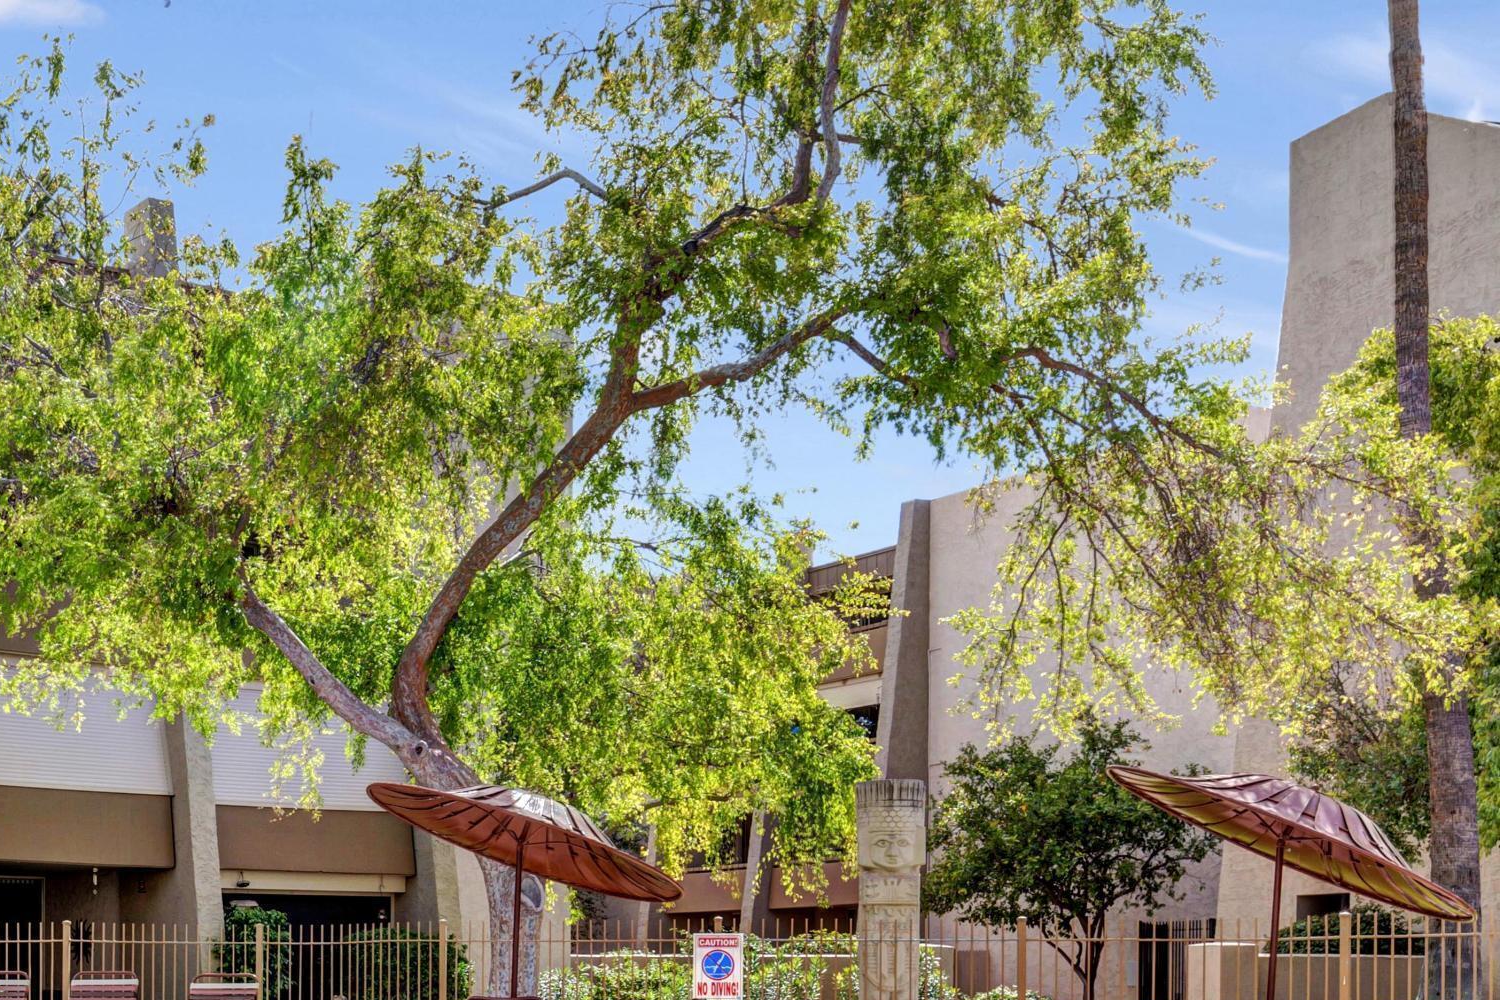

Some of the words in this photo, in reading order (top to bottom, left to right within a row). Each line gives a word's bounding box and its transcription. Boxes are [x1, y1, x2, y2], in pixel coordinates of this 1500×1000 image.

[699, 938, 738, 947] CAUTION!
[697, 982, 708, 996] NO
[711, 982, 739, 996] DIVING!
